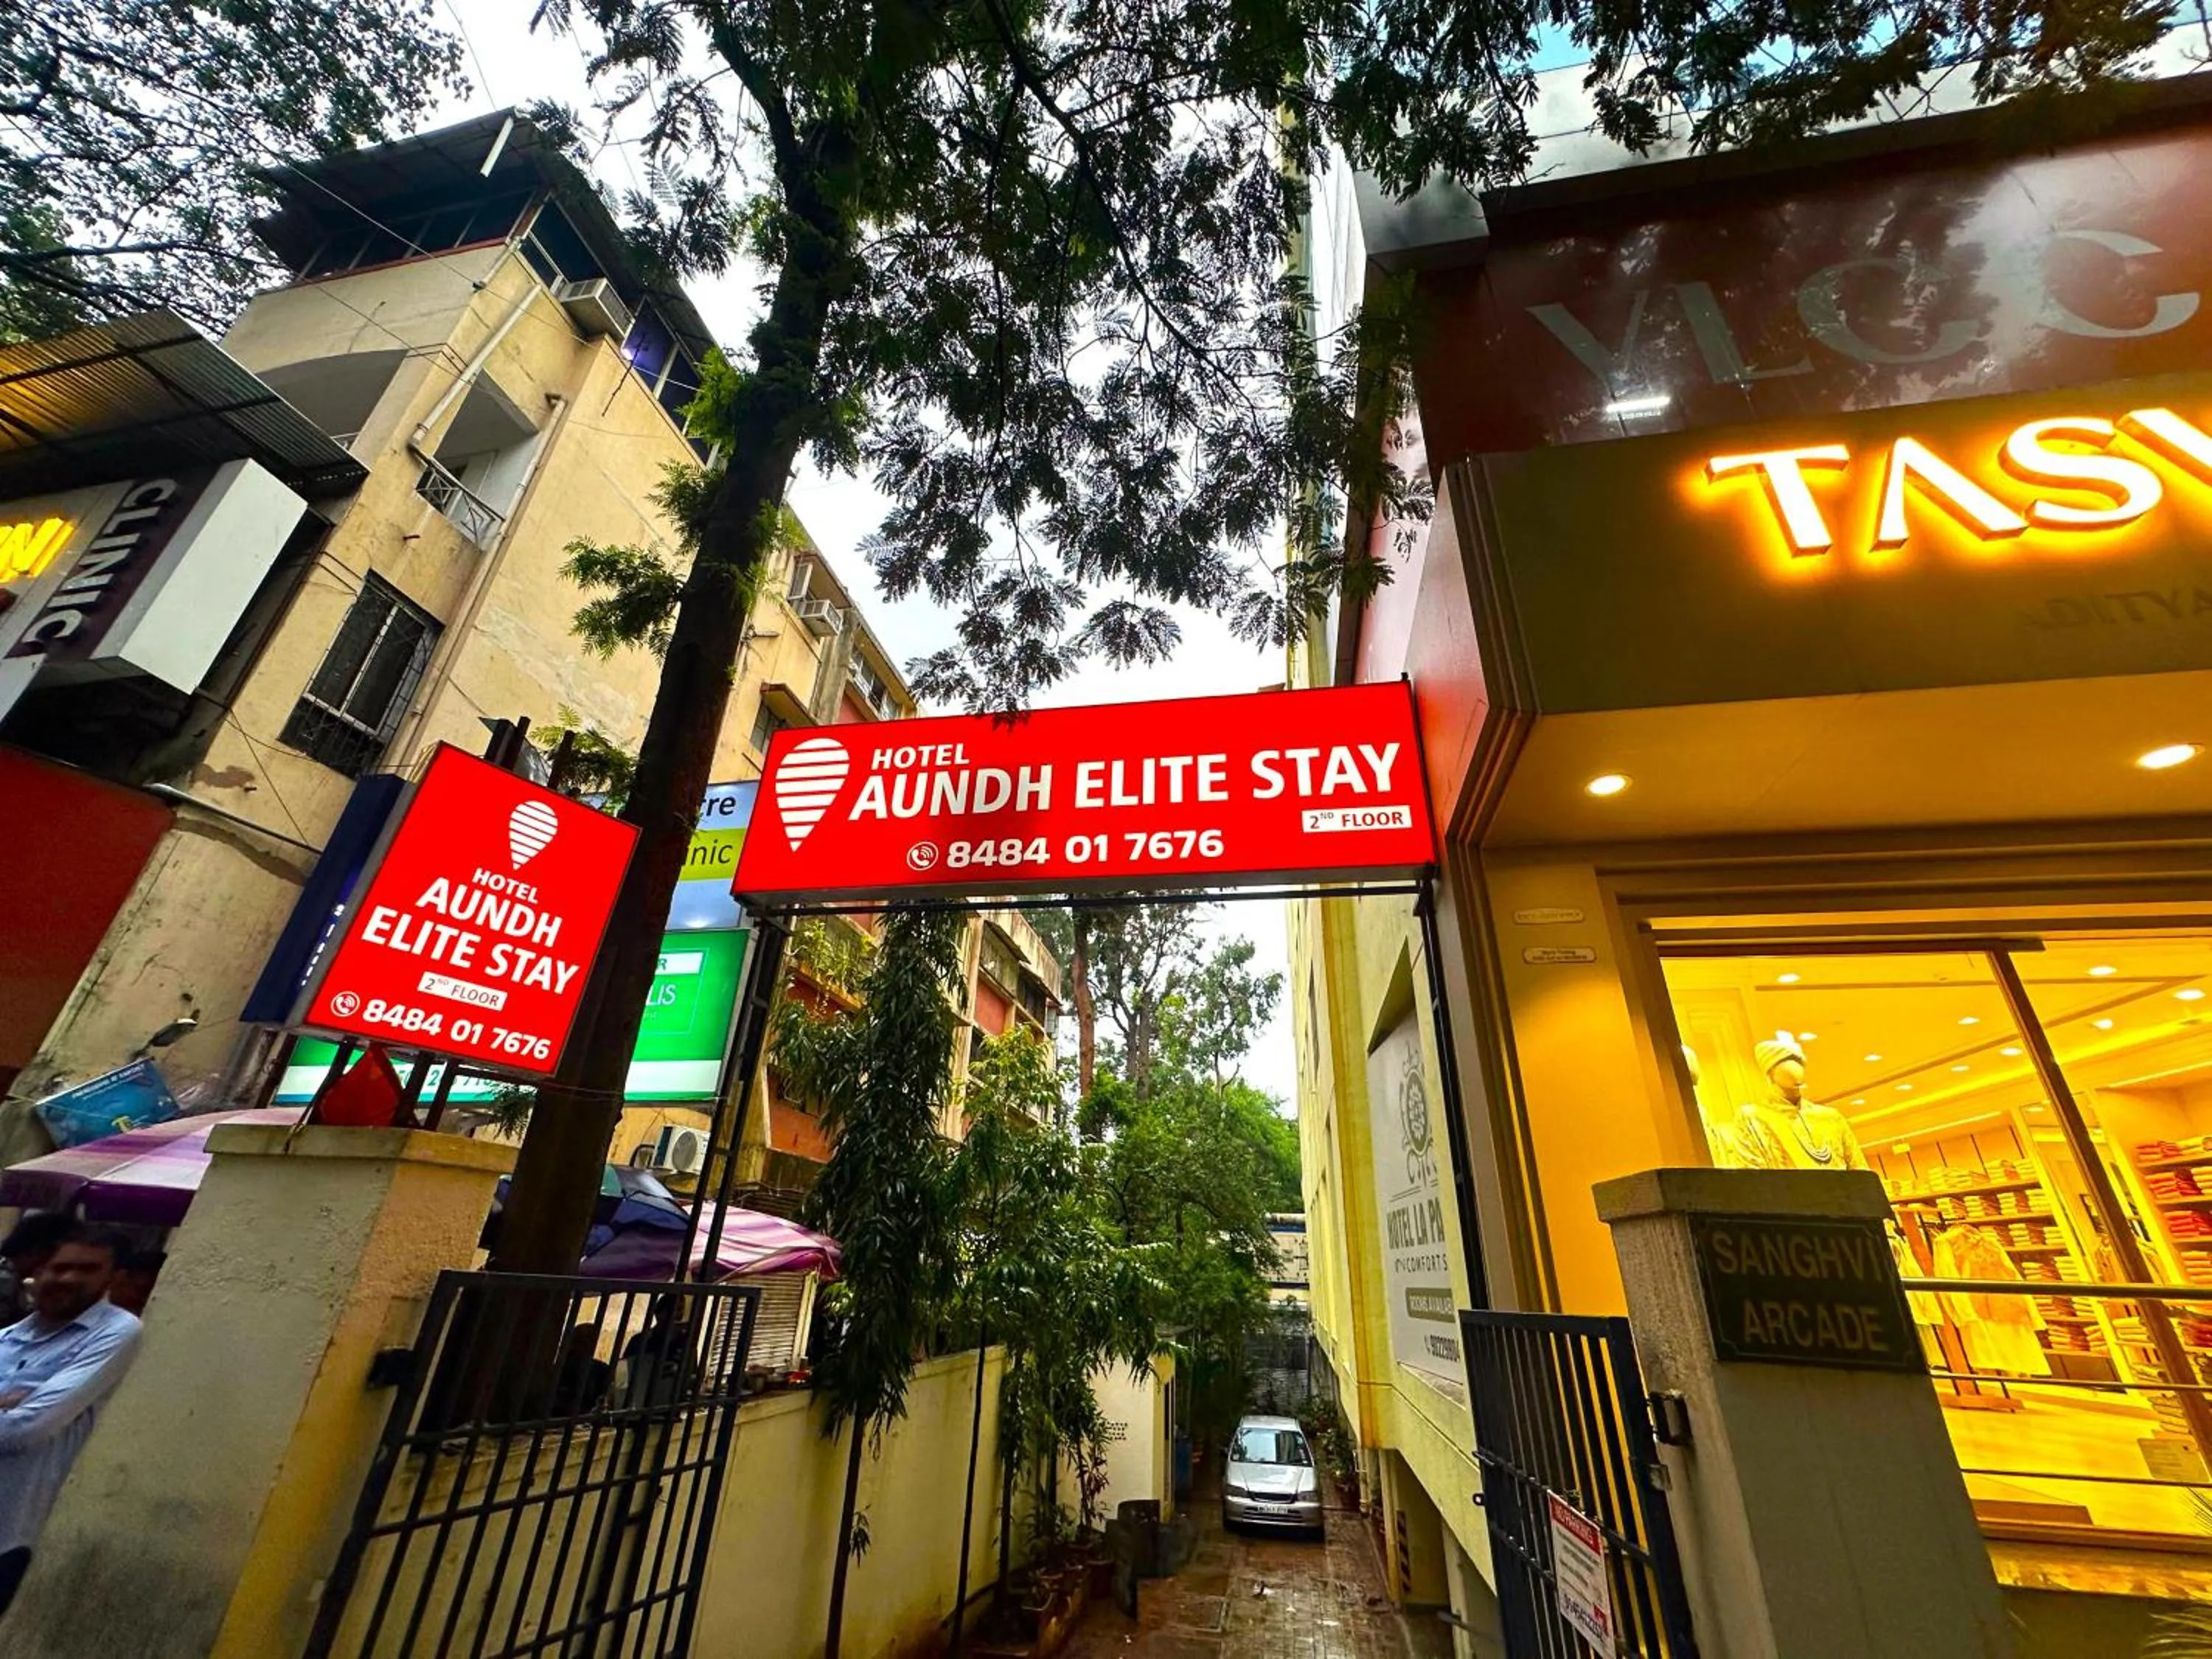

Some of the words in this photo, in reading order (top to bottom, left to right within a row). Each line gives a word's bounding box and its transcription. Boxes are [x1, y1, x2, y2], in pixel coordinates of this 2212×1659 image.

[1525, 230, 2200, 391] VLCC
[21, 479, 177, 644] CLINIC
[848, 765, 1053, 821] AUNDH
[1074, 754, 1229, 809] ELITE
[1251, 742, 1401, 799] STAY
[871, 742, 970, 771] HOTEL
[1309, 811, 1335, 830] 2ND
[1341, 812, 1404, 828] FLOOR
[689, 838, 734, 866] nic
[946, 837, 1051, 869] 8484
[1065, 834, 1109, 864] 01
[1124, 829, 1225, 861] 7676
[414, 876, 563, 948] AUNDH
[471, 867, 538, 905] HOTEL
[361, 905, 482, 969] ELITE
[484, 942, 580, 995] STAY
[424, 977, 451, 992] 2ND
[451, 984, 501, 1007] FLOOR
[645, 983, 677, 1006] LIS
[362, 999, 444, 1036] 8484
[450, 1019, 484, 1045] 01
[490, 1027, 552, 1060] 7676
[1387, 1206, 1415, 1251] HOTEL
[1413, 1202, 1428, 1246] LA
[1427, 1196, 1445, 1245] PA
[1711, 1230, 1883, 1282] SANGHVI
[1742, 1298, 1889, 1352] ARCADE
